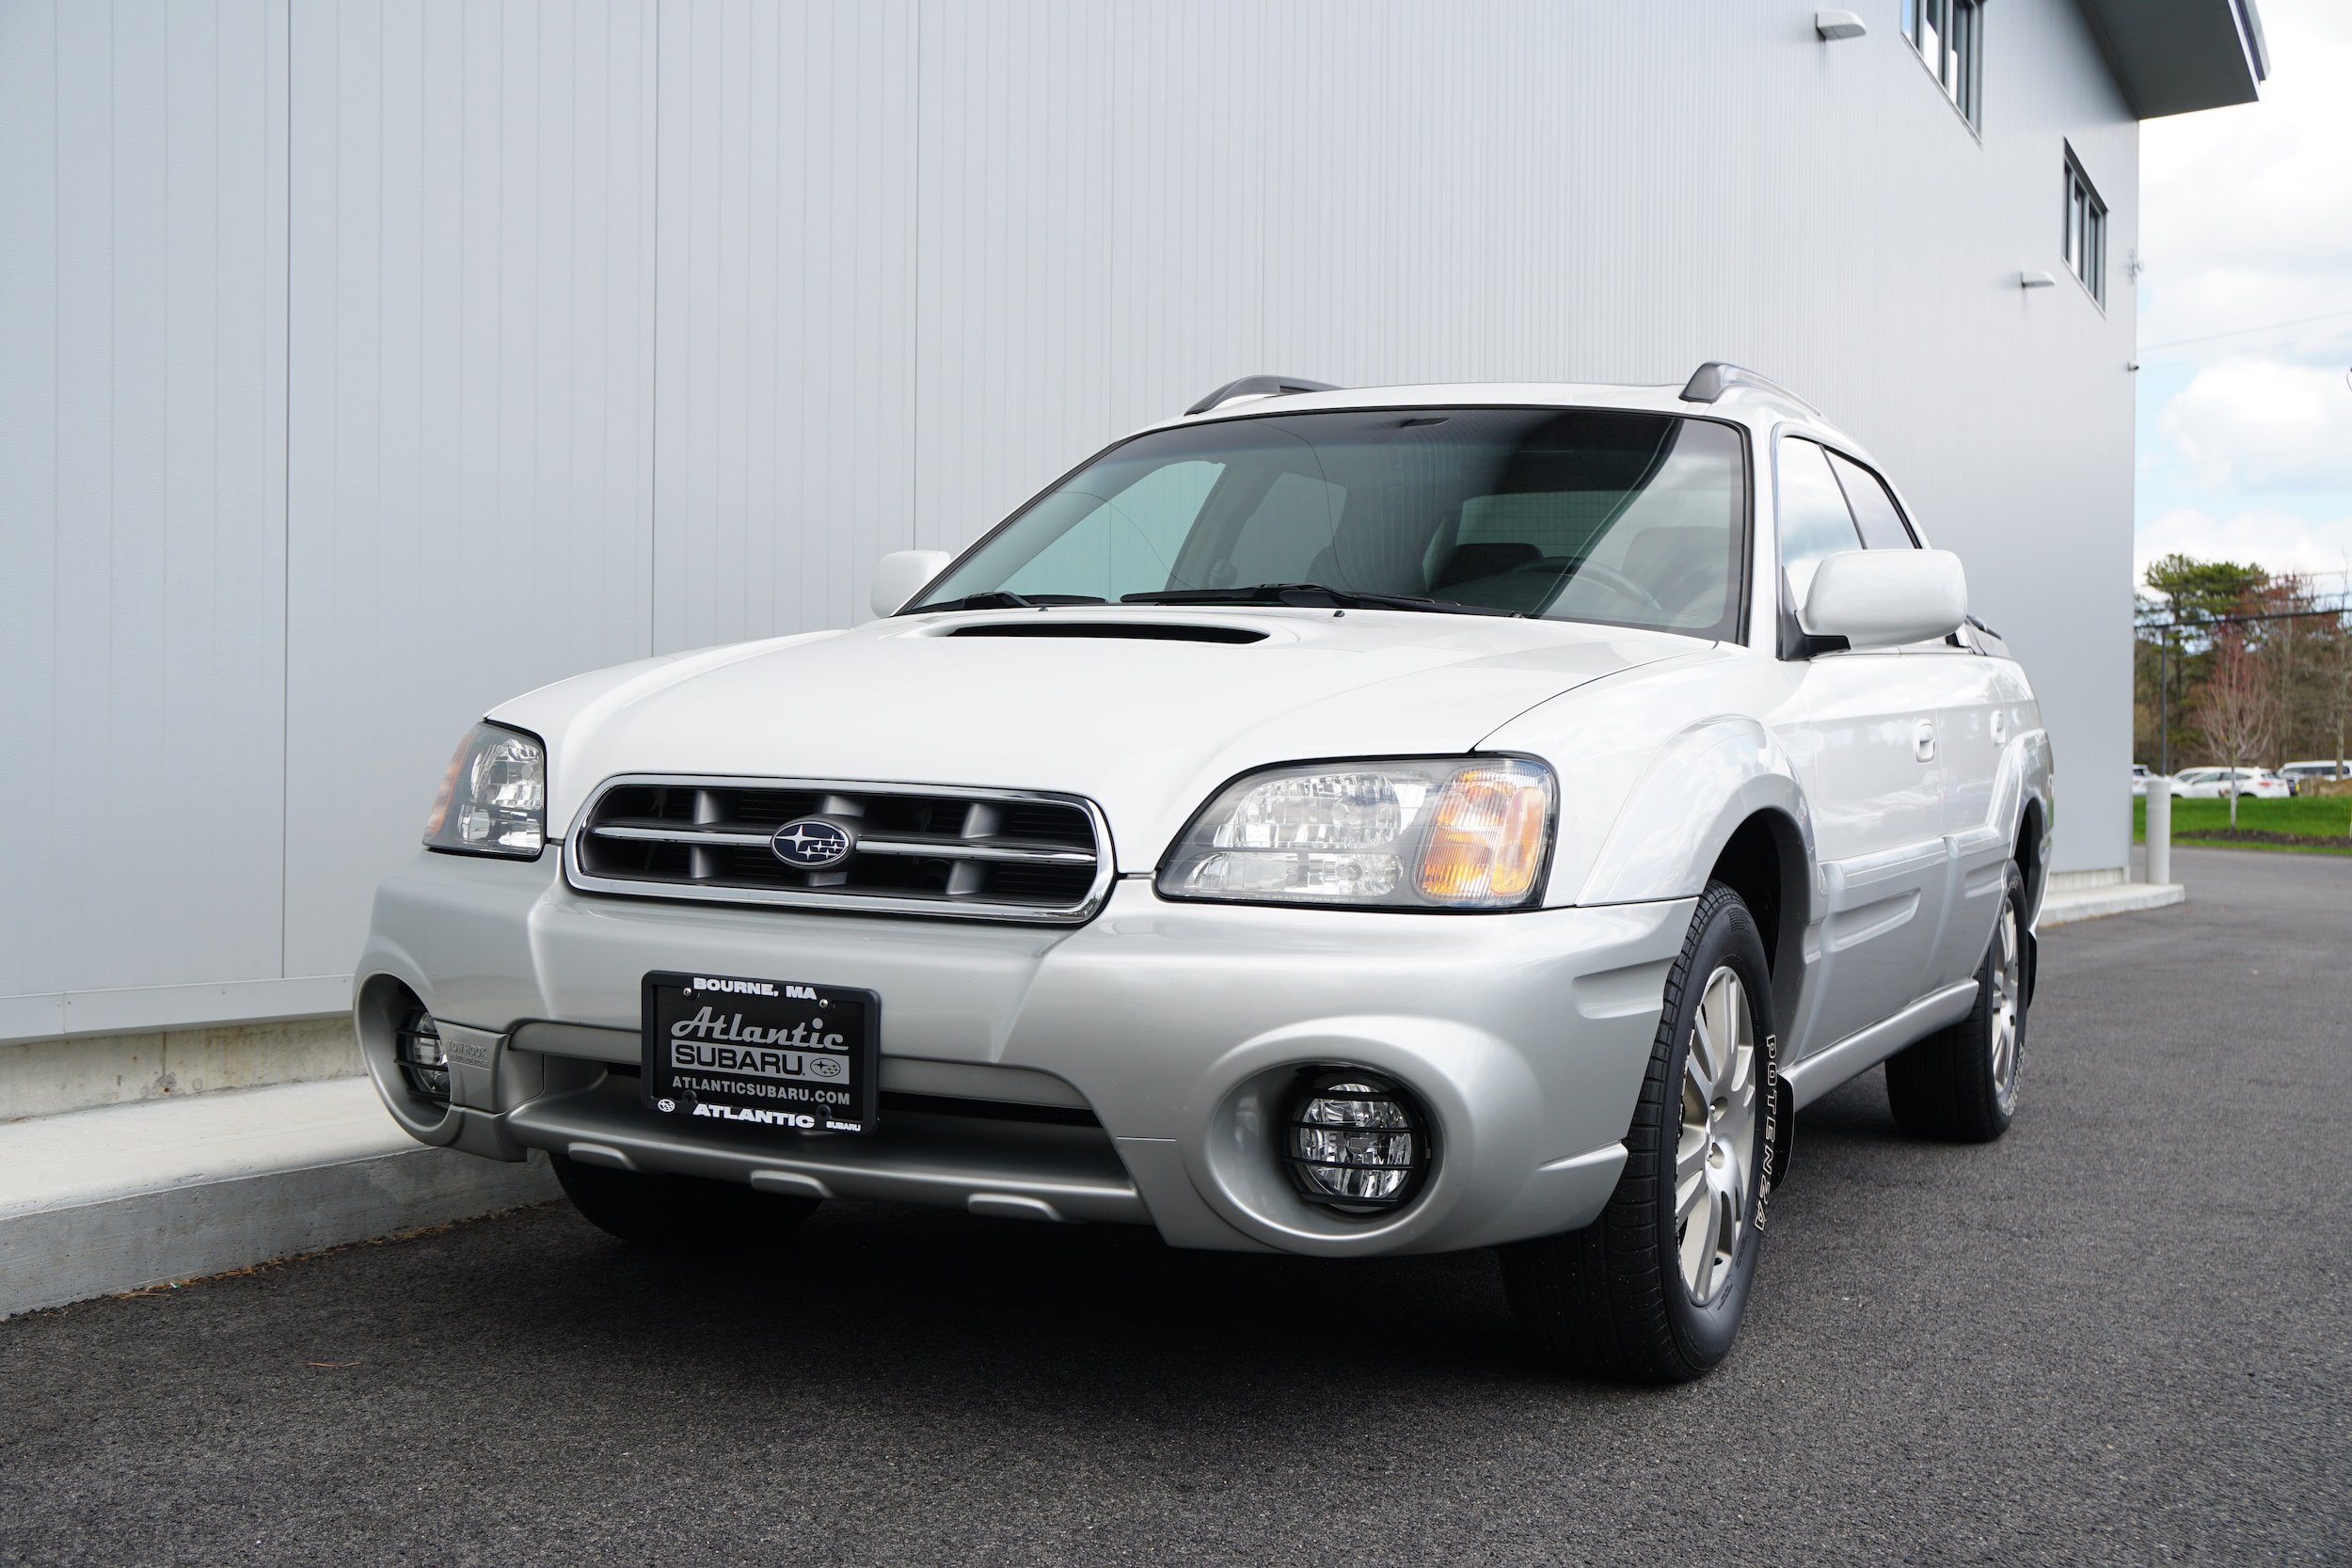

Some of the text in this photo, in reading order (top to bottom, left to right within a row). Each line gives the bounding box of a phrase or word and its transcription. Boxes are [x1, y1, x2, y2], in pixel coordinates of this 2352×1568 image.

[692, 977, 818, 1000] BOURNE, MA
[671, 1006, 850, 1051] Atlantic
[675, 1044, 803, 1076] SUBARU
[672, 1075, 850, 1105] ATLANTICSUBARU.COM
[692, 1103, 862, 1132] ATLANTIC SUBARU
[1755, 1035, 1777, 1231] POTENZA
